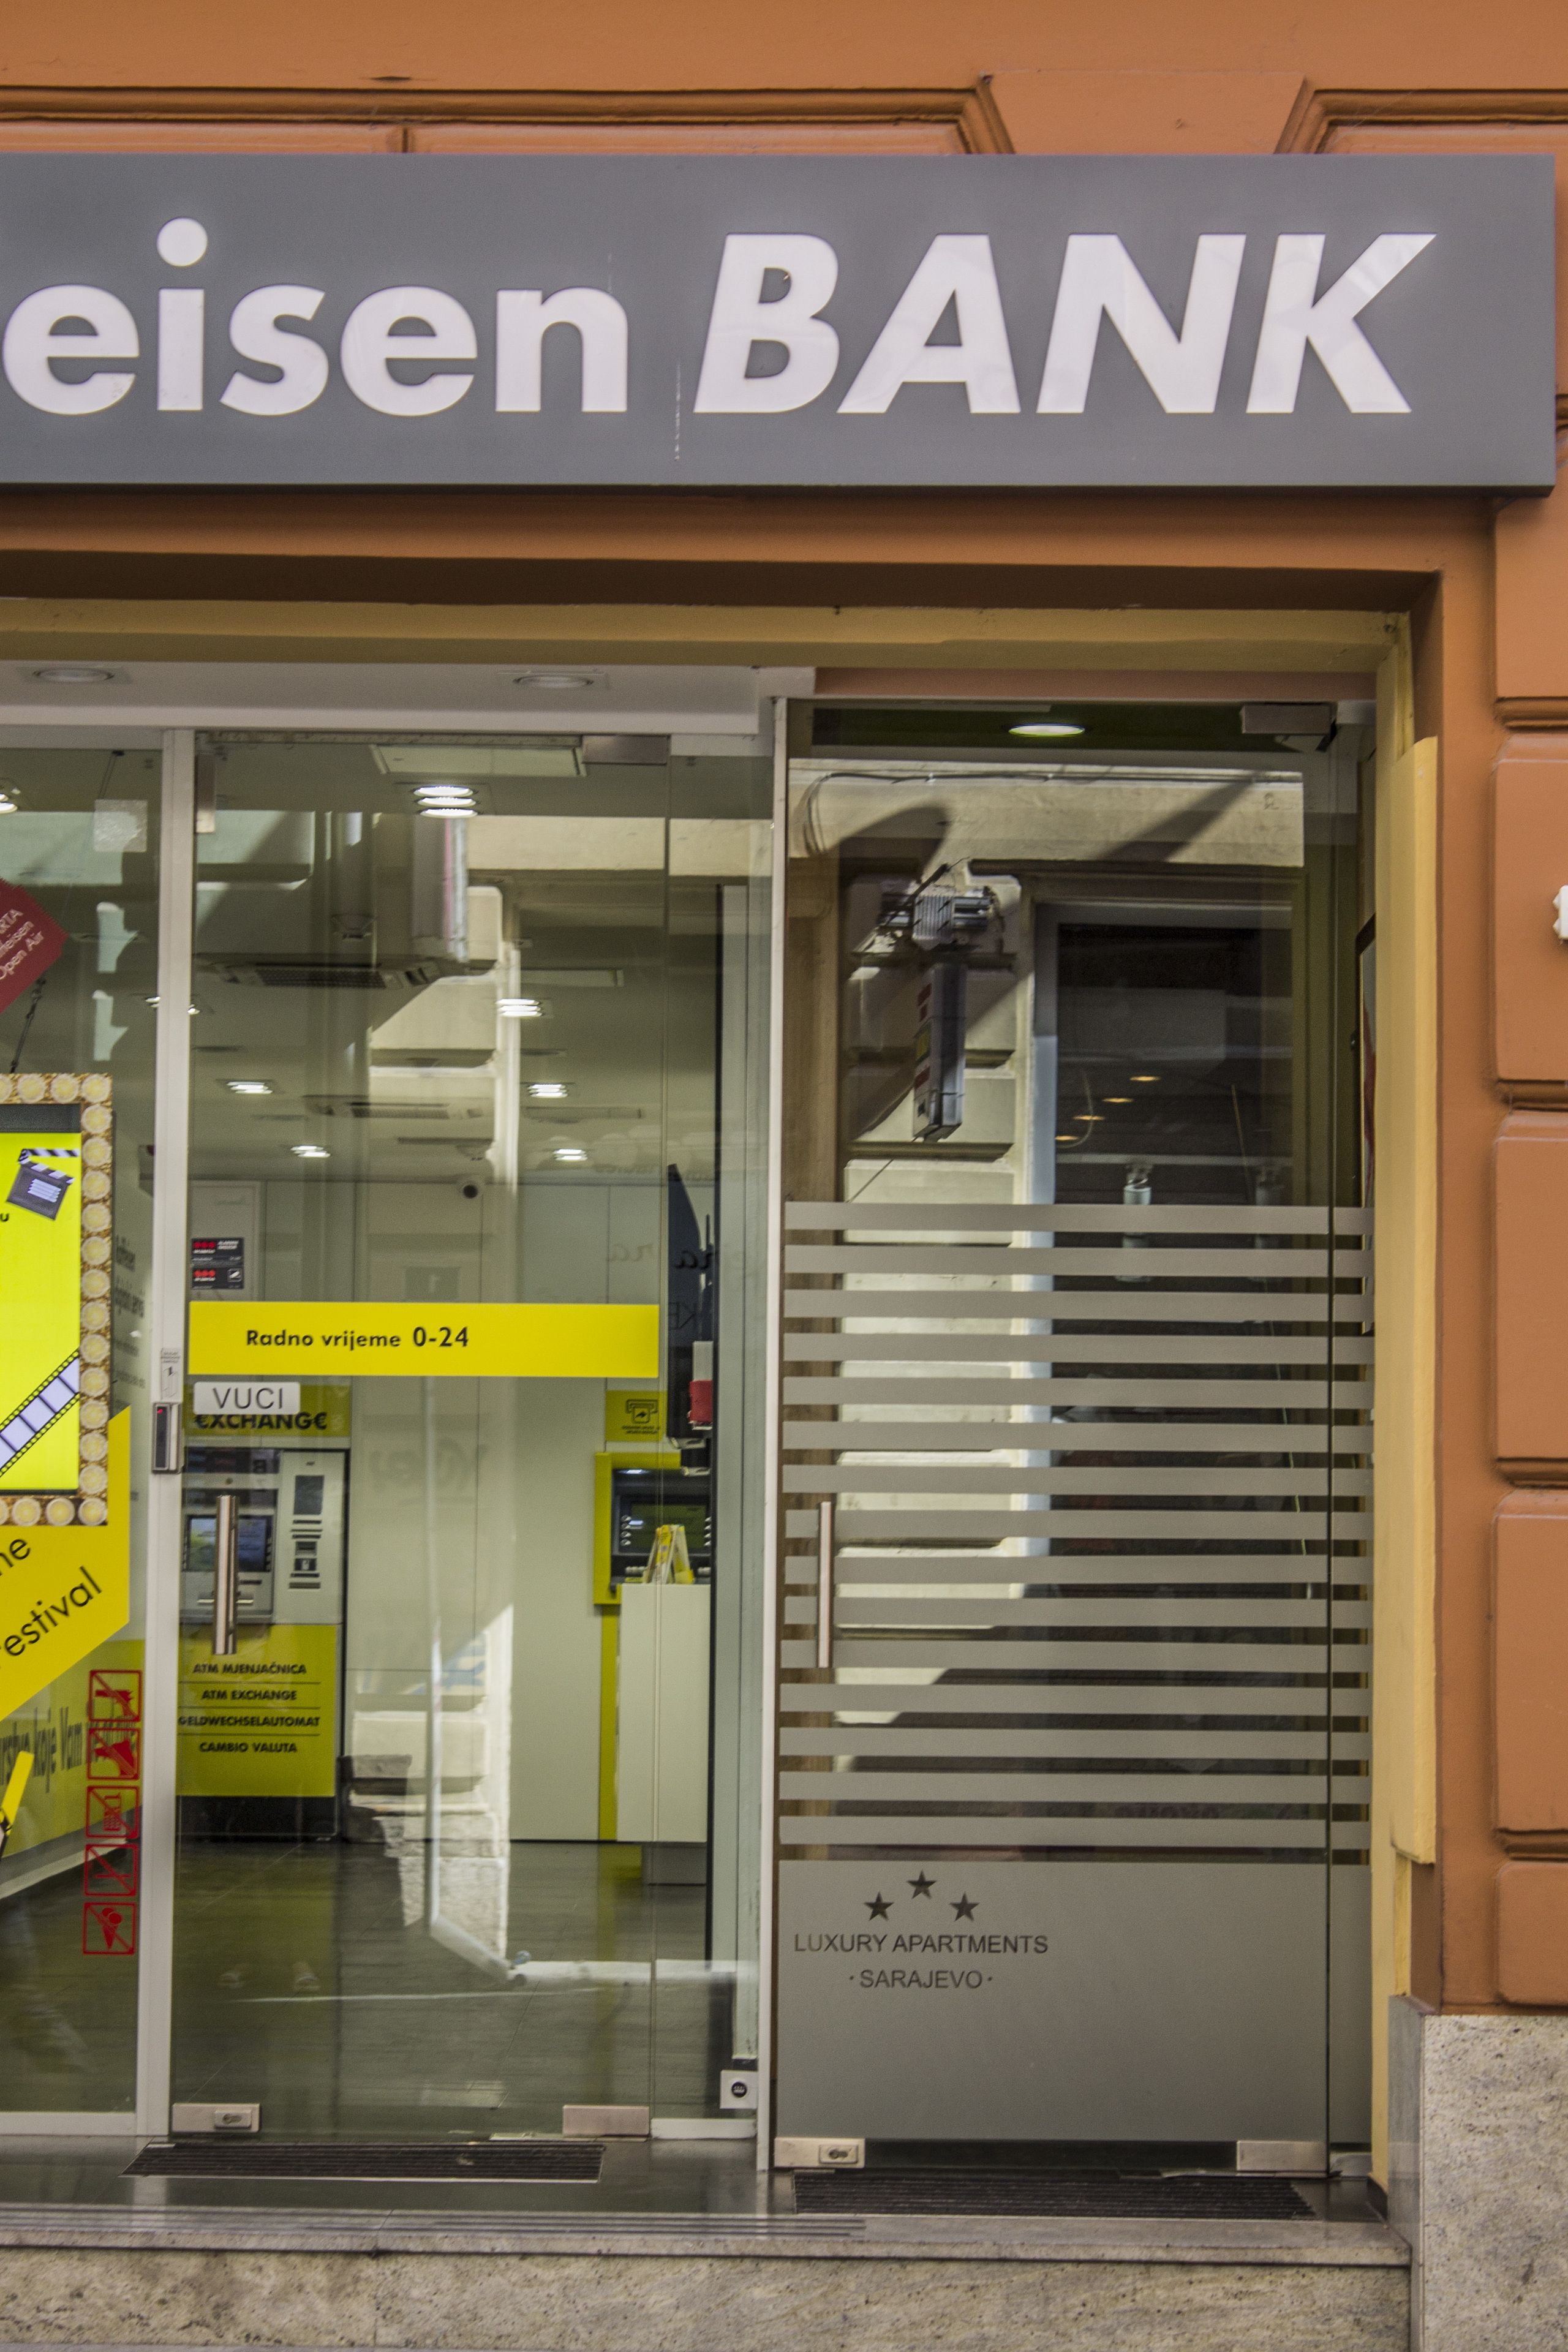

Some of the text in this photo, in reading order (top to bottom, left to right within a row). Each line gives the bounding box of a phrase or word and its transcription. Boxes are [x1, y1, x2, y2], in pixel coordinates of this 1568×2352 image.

[2, 217, 1438, 416] eisen BANK
[25, 931, 44, 952] Air
[246, 1326, 469, 1351] Radno vrijeme 0-24
[212, 1387, 284, 1410] VUCI
[193, 1661, 307, 1674] ATM MJENJAČNICA
[201, 1689, 298, 1701] ATM EXCHANGE
[178, 1716, 320, 1727] GELDWECHSELAUTOMAT
[59, 1706, 83, 1771] Vam
[199, 1742, 298, 1753] CAMBIO VALUTA
[794, 1934, 1049, 1954] LUXURY APARTMENTS
